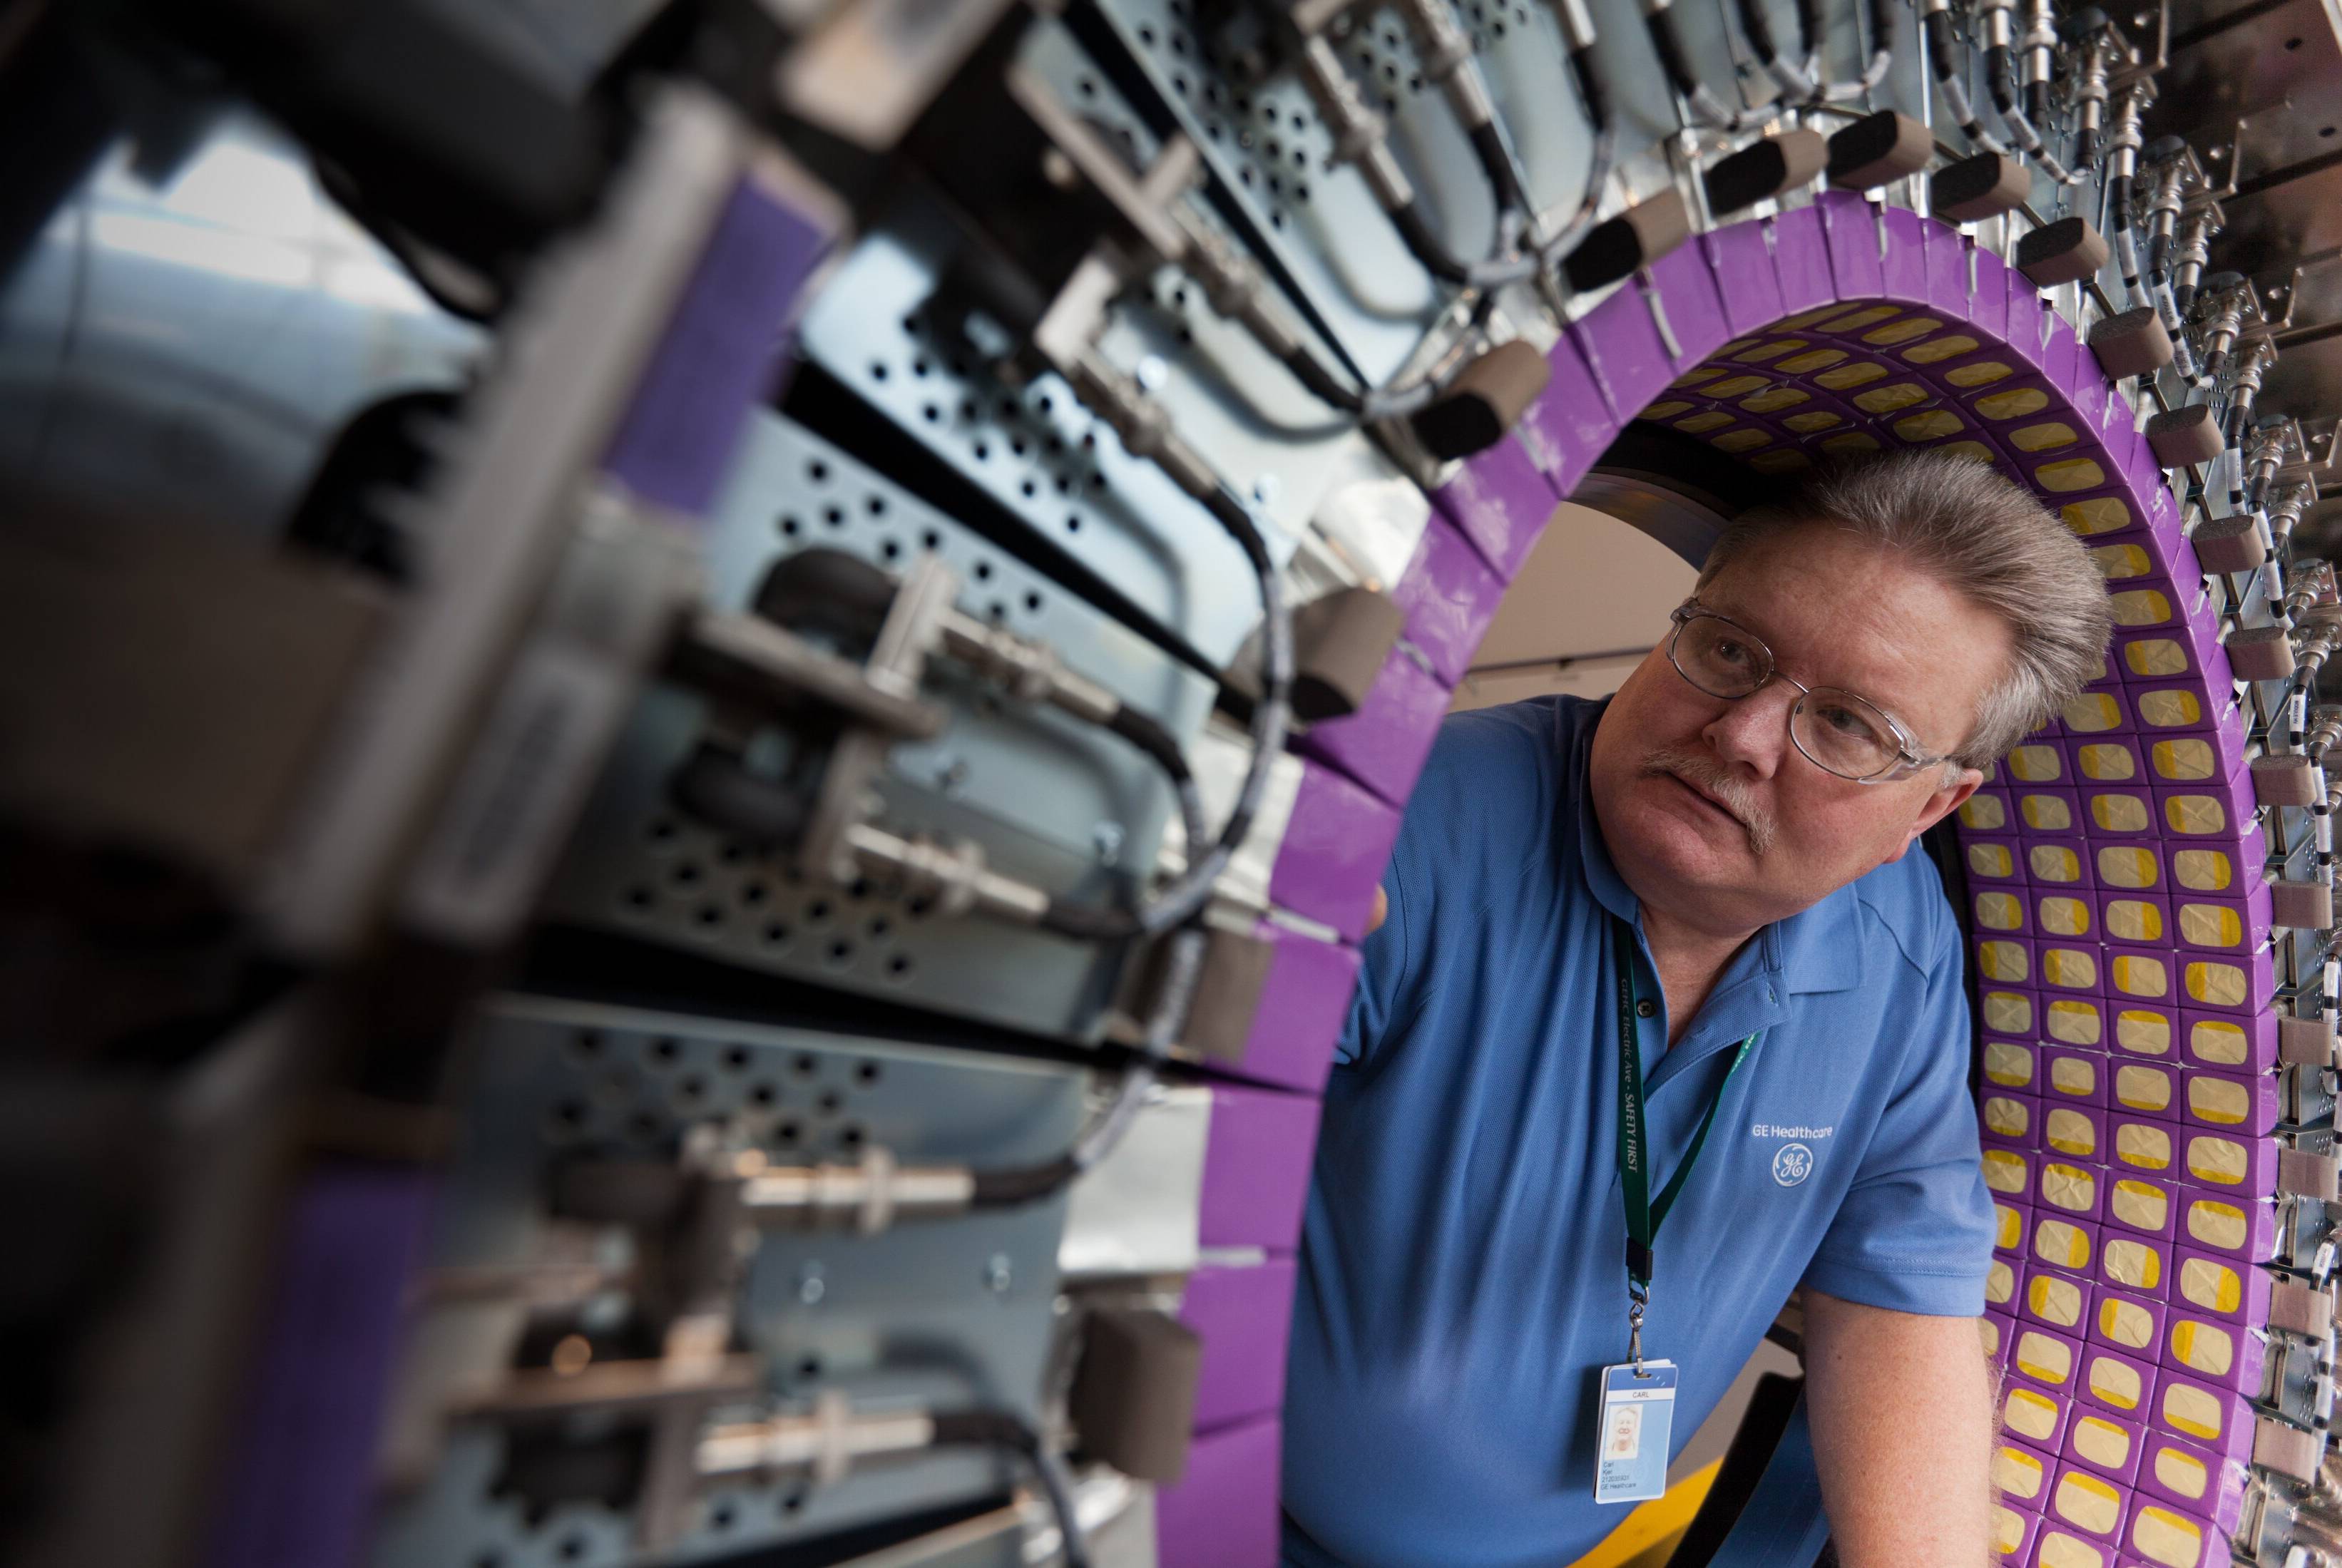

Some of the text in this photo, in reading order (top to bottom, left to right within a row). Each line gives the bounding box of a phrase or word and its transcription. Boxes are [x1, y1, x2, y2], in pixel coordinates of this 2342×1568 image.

[1620, 978, 1630, 1013] GEHC
[1623, 1017, 1632, 1059] Electric
[1625, 1060, 1633, 1082] Ave
[1625, 1093, 1637, 1137] SAFETY
[1752, 1124, 1833, 1139] GE Healthcare
[1627, 1139, 1638, 1173] FIRST
